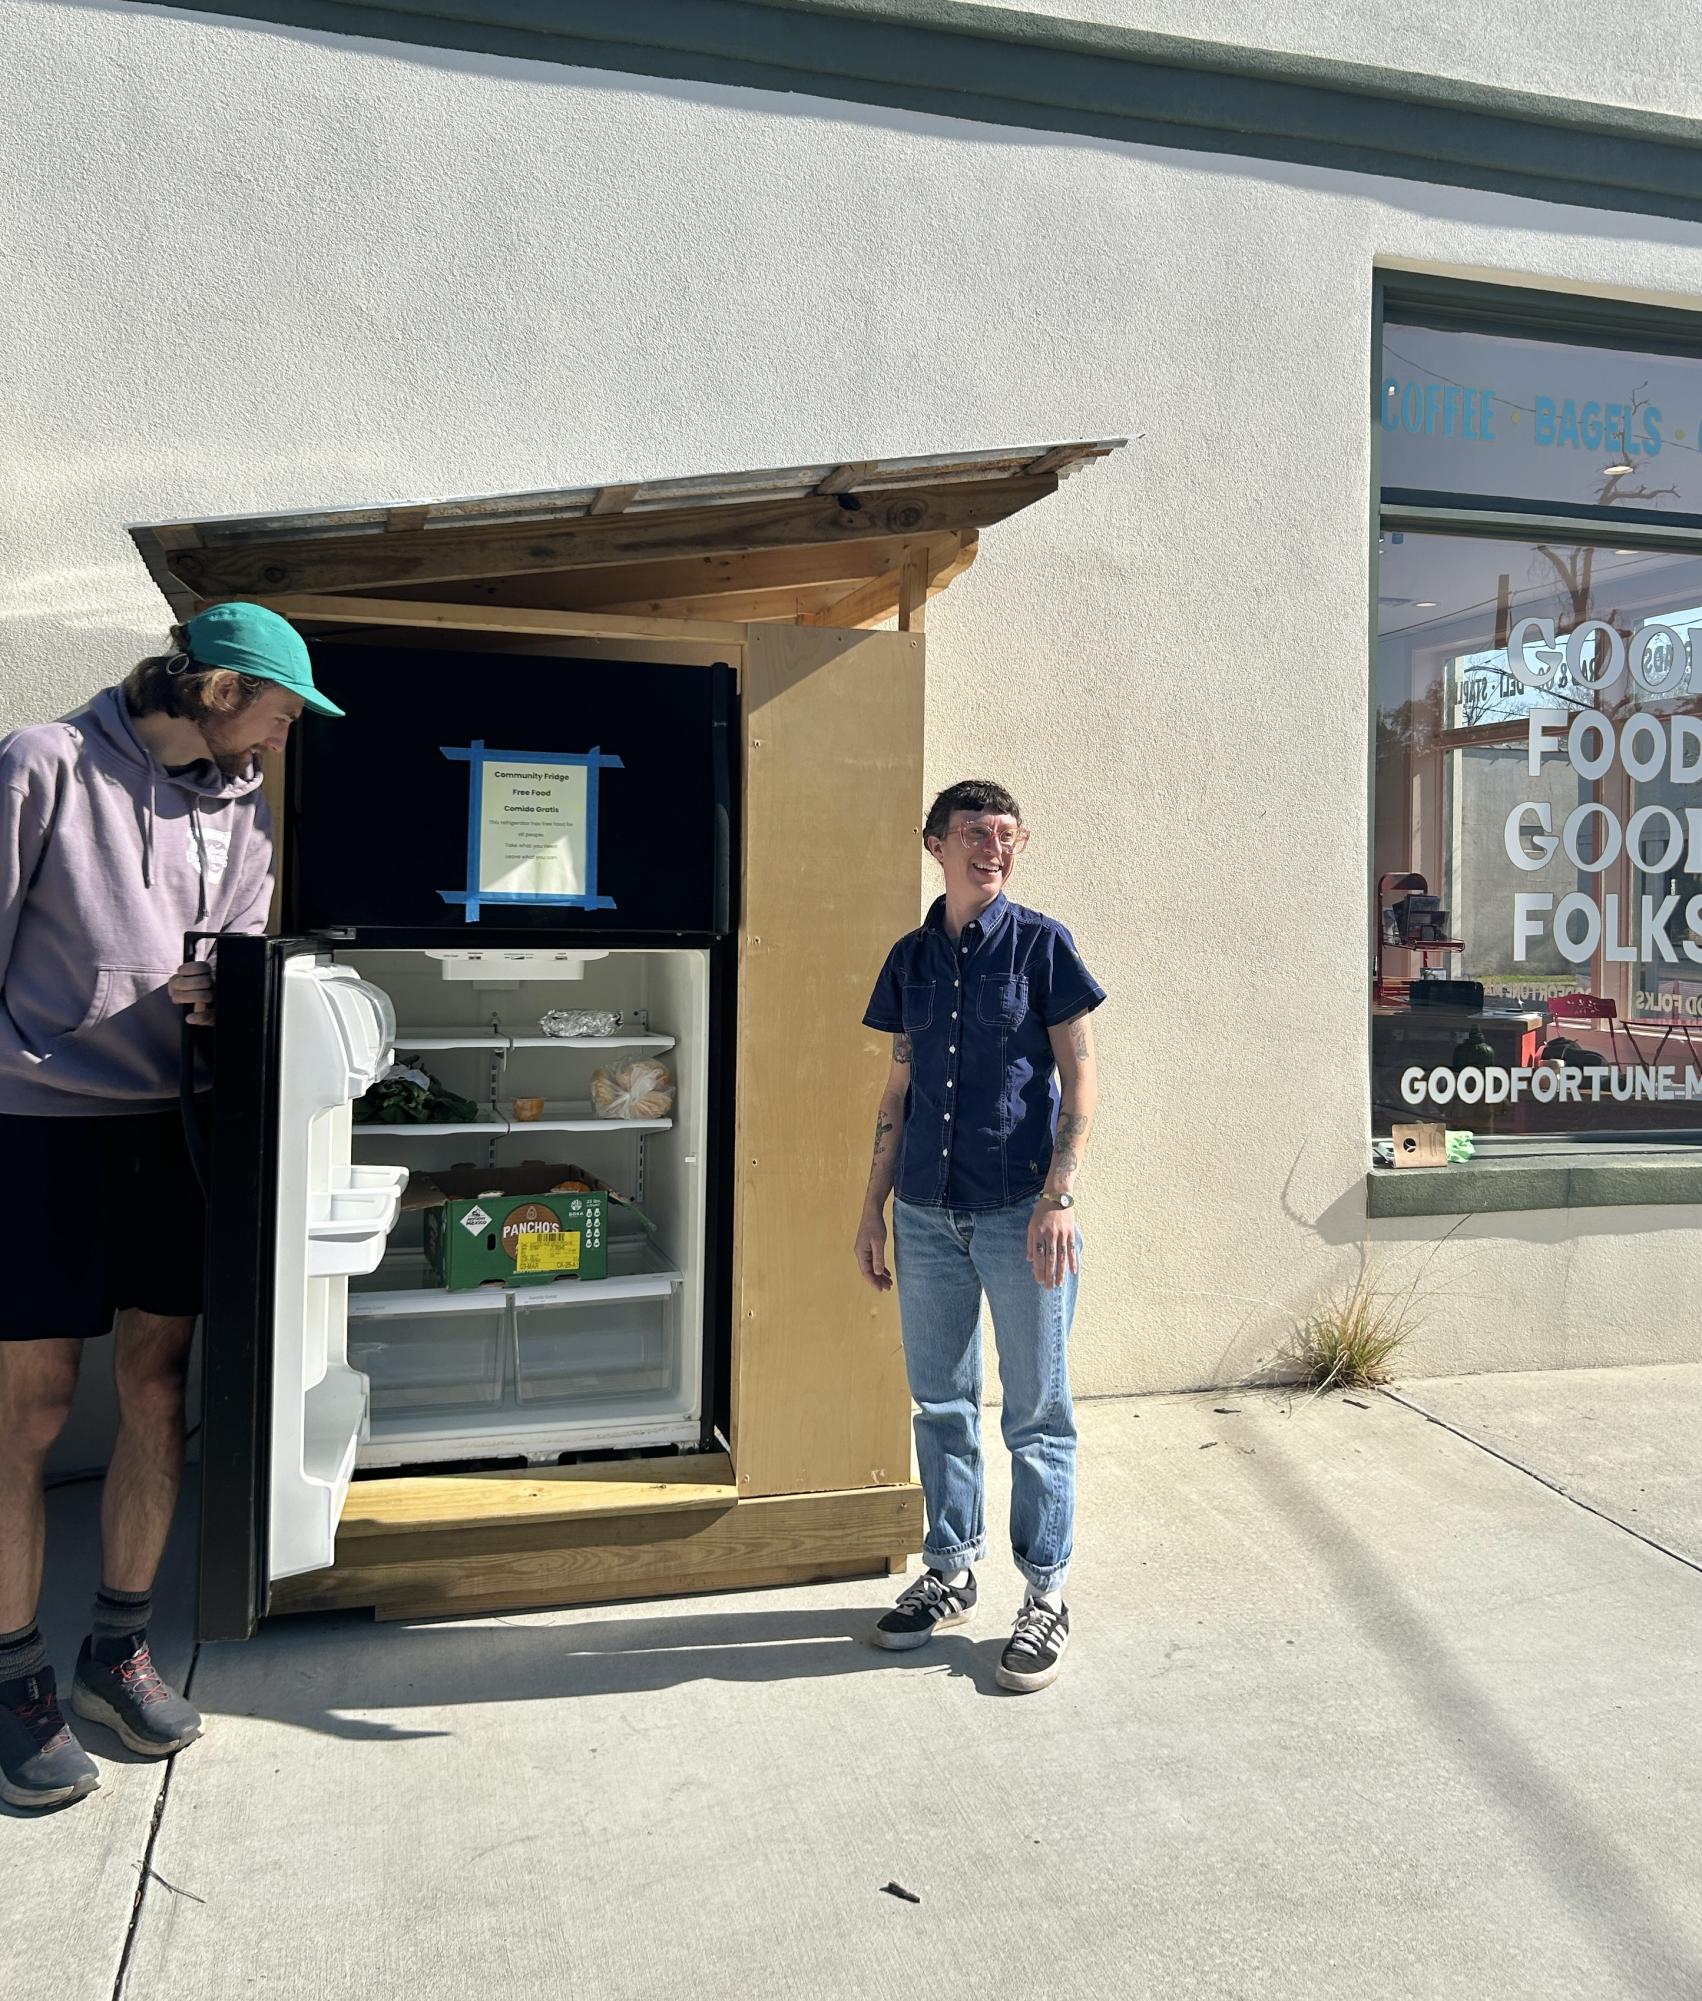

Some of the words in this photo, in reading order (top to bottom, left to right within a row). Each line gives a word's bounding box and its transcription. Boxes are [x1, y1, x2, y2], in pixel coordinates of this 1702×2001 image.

[1381, 377, 1498, 441] COFFEE
[1534, 395, 1663, 457] BAGELS
[1507, 617, 1702, 694] GOO
[494, 771, 543, 781] Community
[544, 773, 570, 782] Fridge
[1527, 708, 1702, 784] FOOD
[1504, 802, 1702, 874] GOO
[1513, 891, 1702, 964] FOLKS
[1401, 1066, 1676, 1105] GOODFORTUNE
[503, 1221, 560, 1238] PANCHO'S
